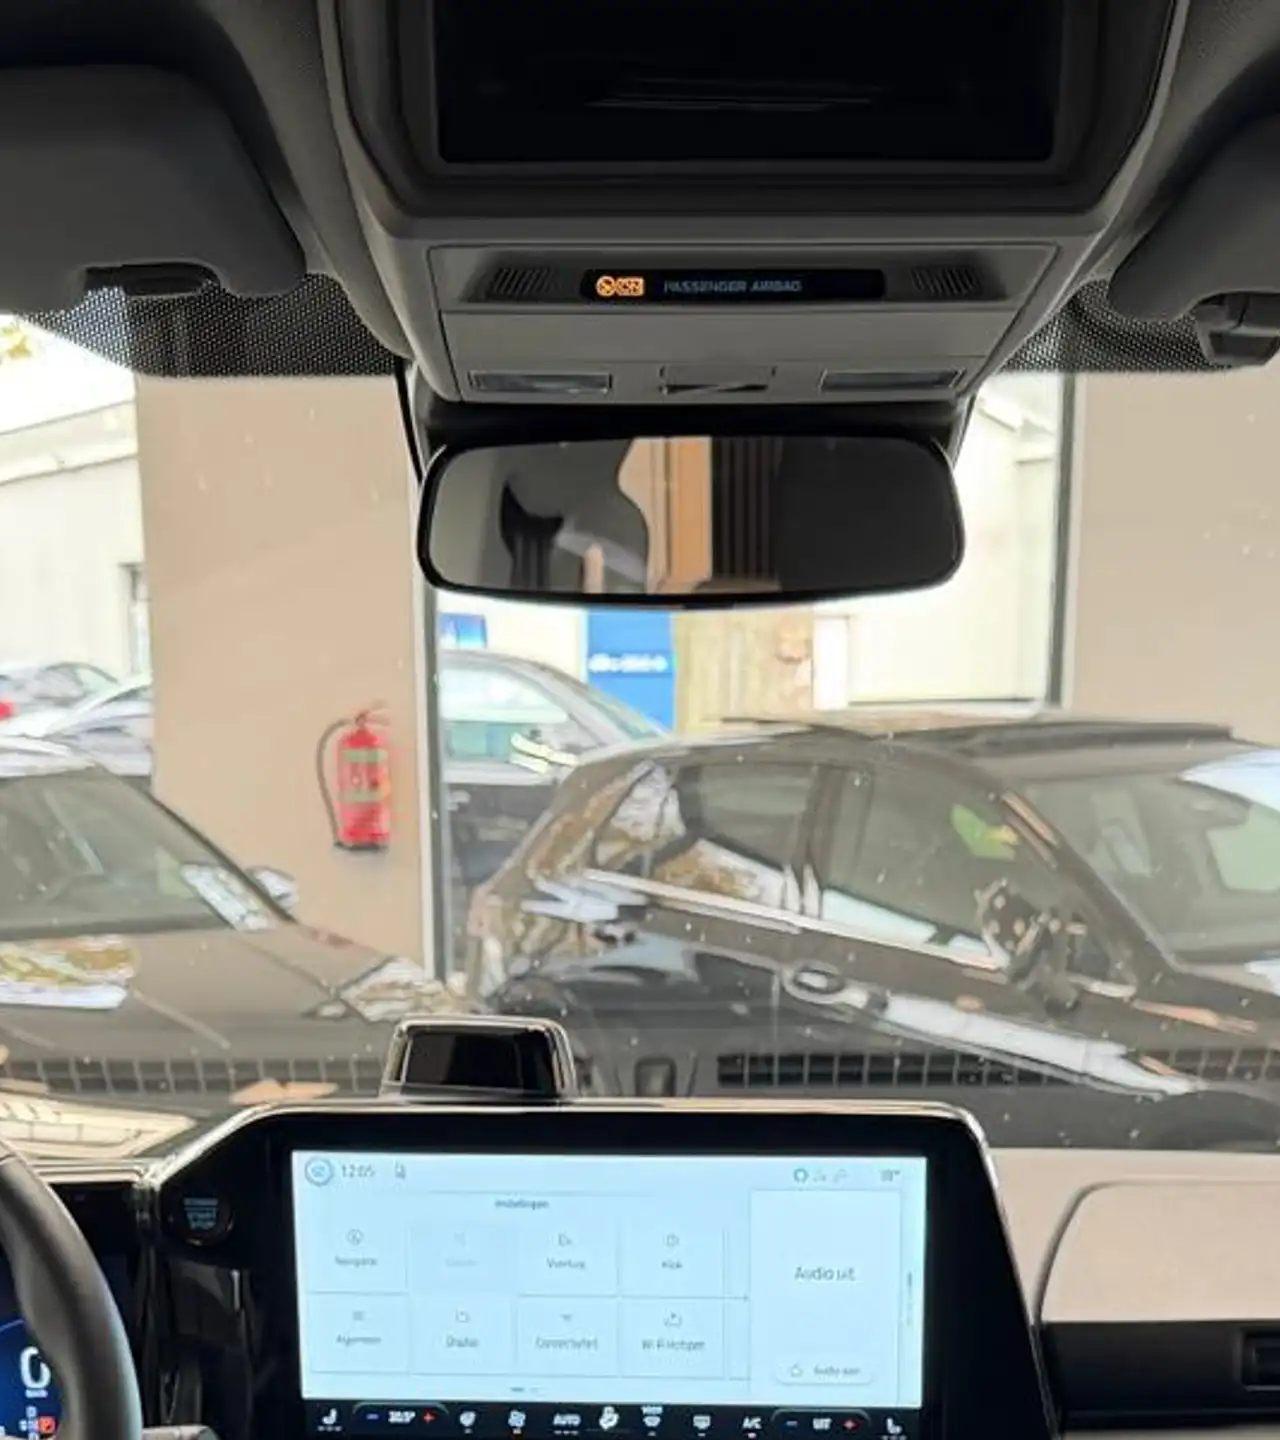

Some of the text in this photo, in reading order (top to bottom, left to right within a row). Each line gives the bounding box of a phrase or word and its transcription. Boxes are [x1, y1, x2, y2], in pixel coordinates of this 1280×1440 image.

[663, 279, 803, 294] PASSENGER AIRBAG
[341, 1164, 376, 1178] 12:05
[794, 1266, 835, 1281] Audio
[552, 1413, 581, 1426] AUTO
